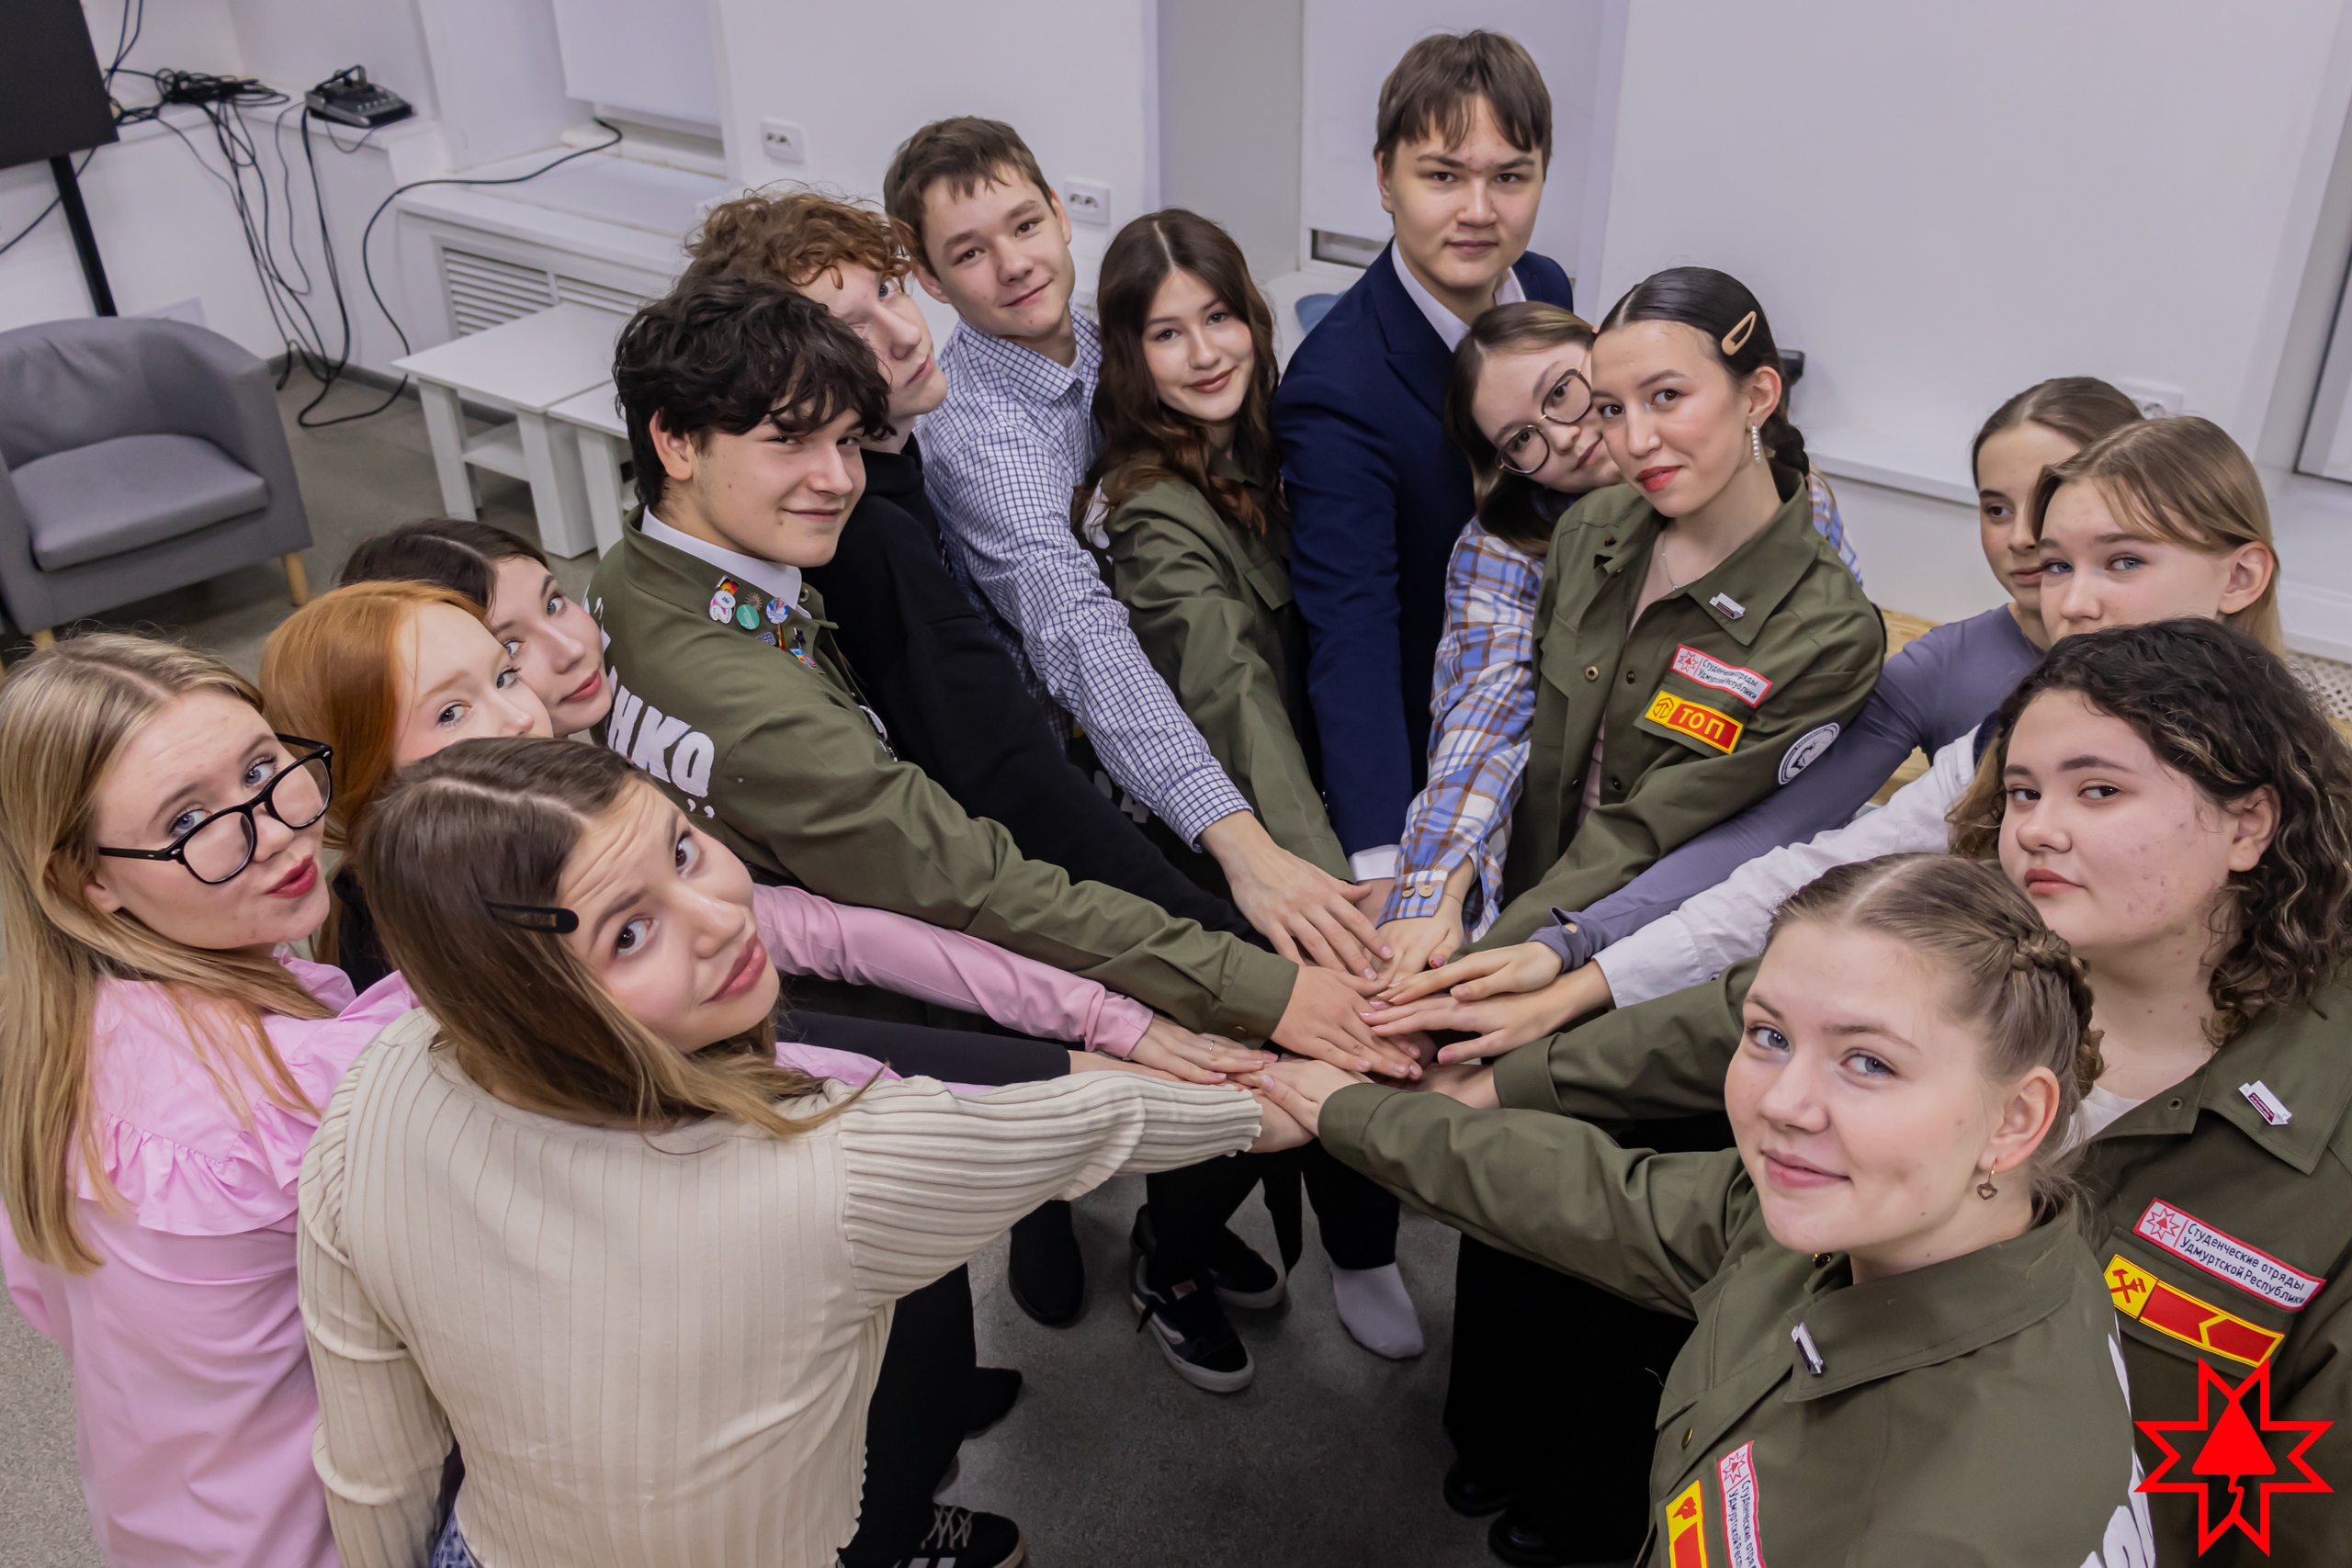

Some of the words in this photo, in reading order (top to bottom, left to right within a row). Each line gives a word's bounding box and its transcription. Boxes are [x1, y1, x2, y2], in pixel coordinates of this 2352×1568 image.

[607, 667, 715, 797] НКО
[1678, 707, 1725, 740] ТОП
[2179, 1236, 2245, 1279] Удмуртской
[2244, 1270, 2306, 1304] Республики
[2188, 1224, 2259, 1268] Студенческие
[2261, 1259, 2305, 1292] отряды
[1727, 1489, 1742, 1546] Удмуртской
